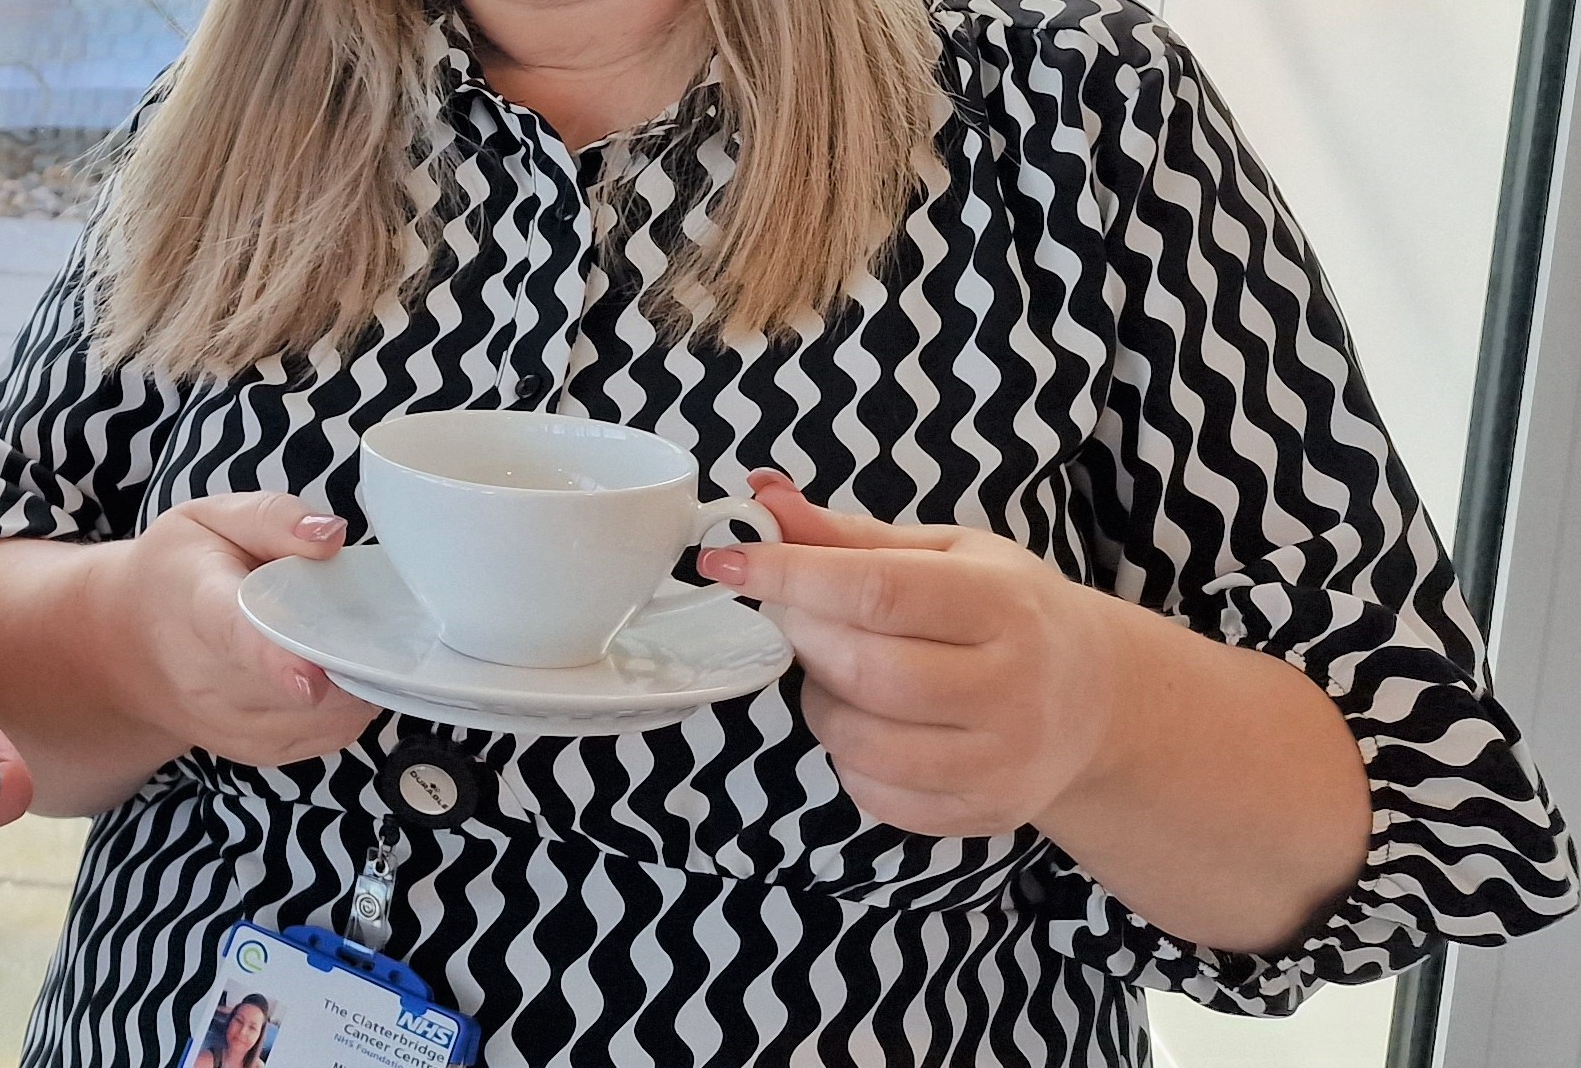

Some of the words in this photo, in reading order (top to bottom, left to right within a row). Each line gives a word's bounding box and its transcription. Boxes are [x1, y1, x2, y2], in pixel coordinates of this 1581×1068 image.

[409, 770, 449, 810] DURABLE
[324, 998, 348, 1018] The
[352, 1013, 445, 1063] Clatterbridge
[333, 1033, 354, 1048] NHS
[344, 1024, 391, 1052] Cancer
[394, 1047, 438, 1068] Centr
[397, 1010, 453, 1046] NHS
